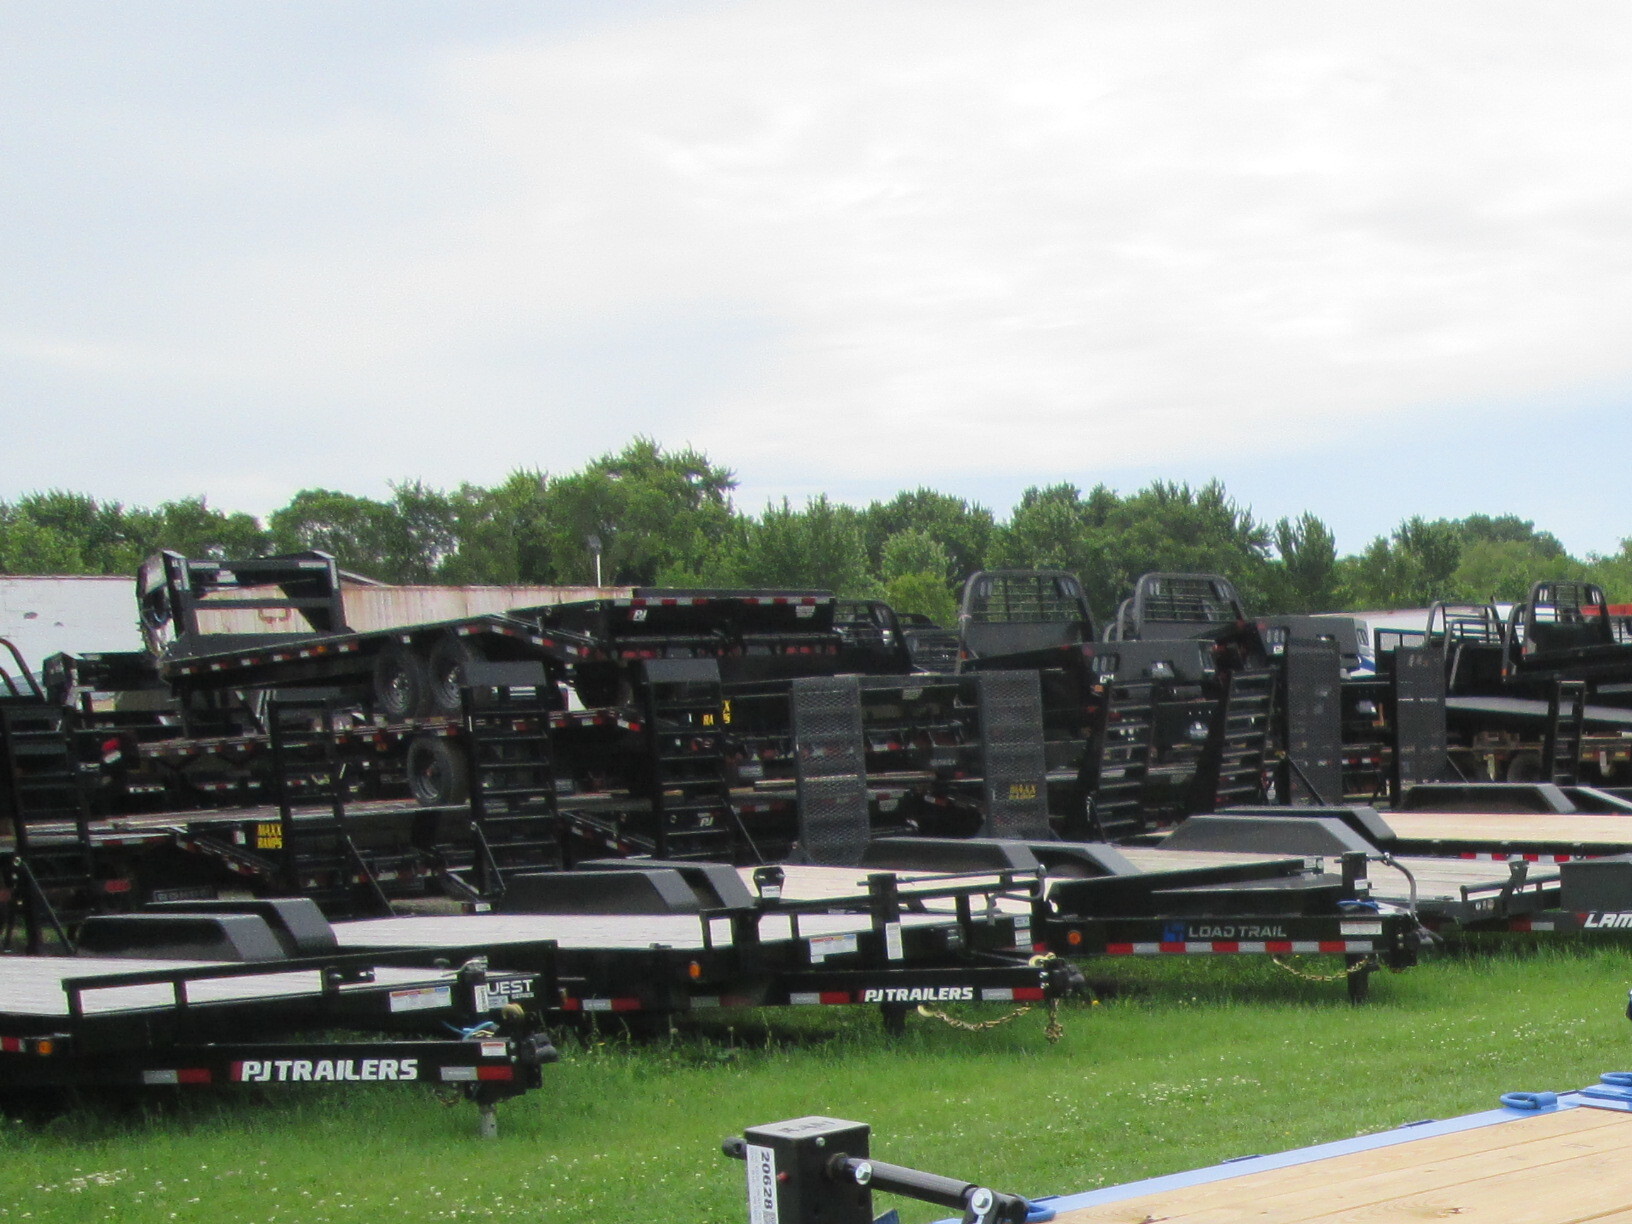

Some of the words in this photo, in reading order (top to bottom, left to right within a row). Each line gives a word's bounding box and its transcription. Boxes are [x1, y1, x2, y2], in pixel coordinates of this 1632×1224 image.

[1188, 926, 1235, 938] LOAD
[1238, 925, 1287, 937] TRAIL
[487, 979, 534, 996] UEST
[885, 987, 974, 1001] TRAILERS
[274, 1058, 418, 1081] TRAILERS
[761, 1150, 774, 1211] 20628
